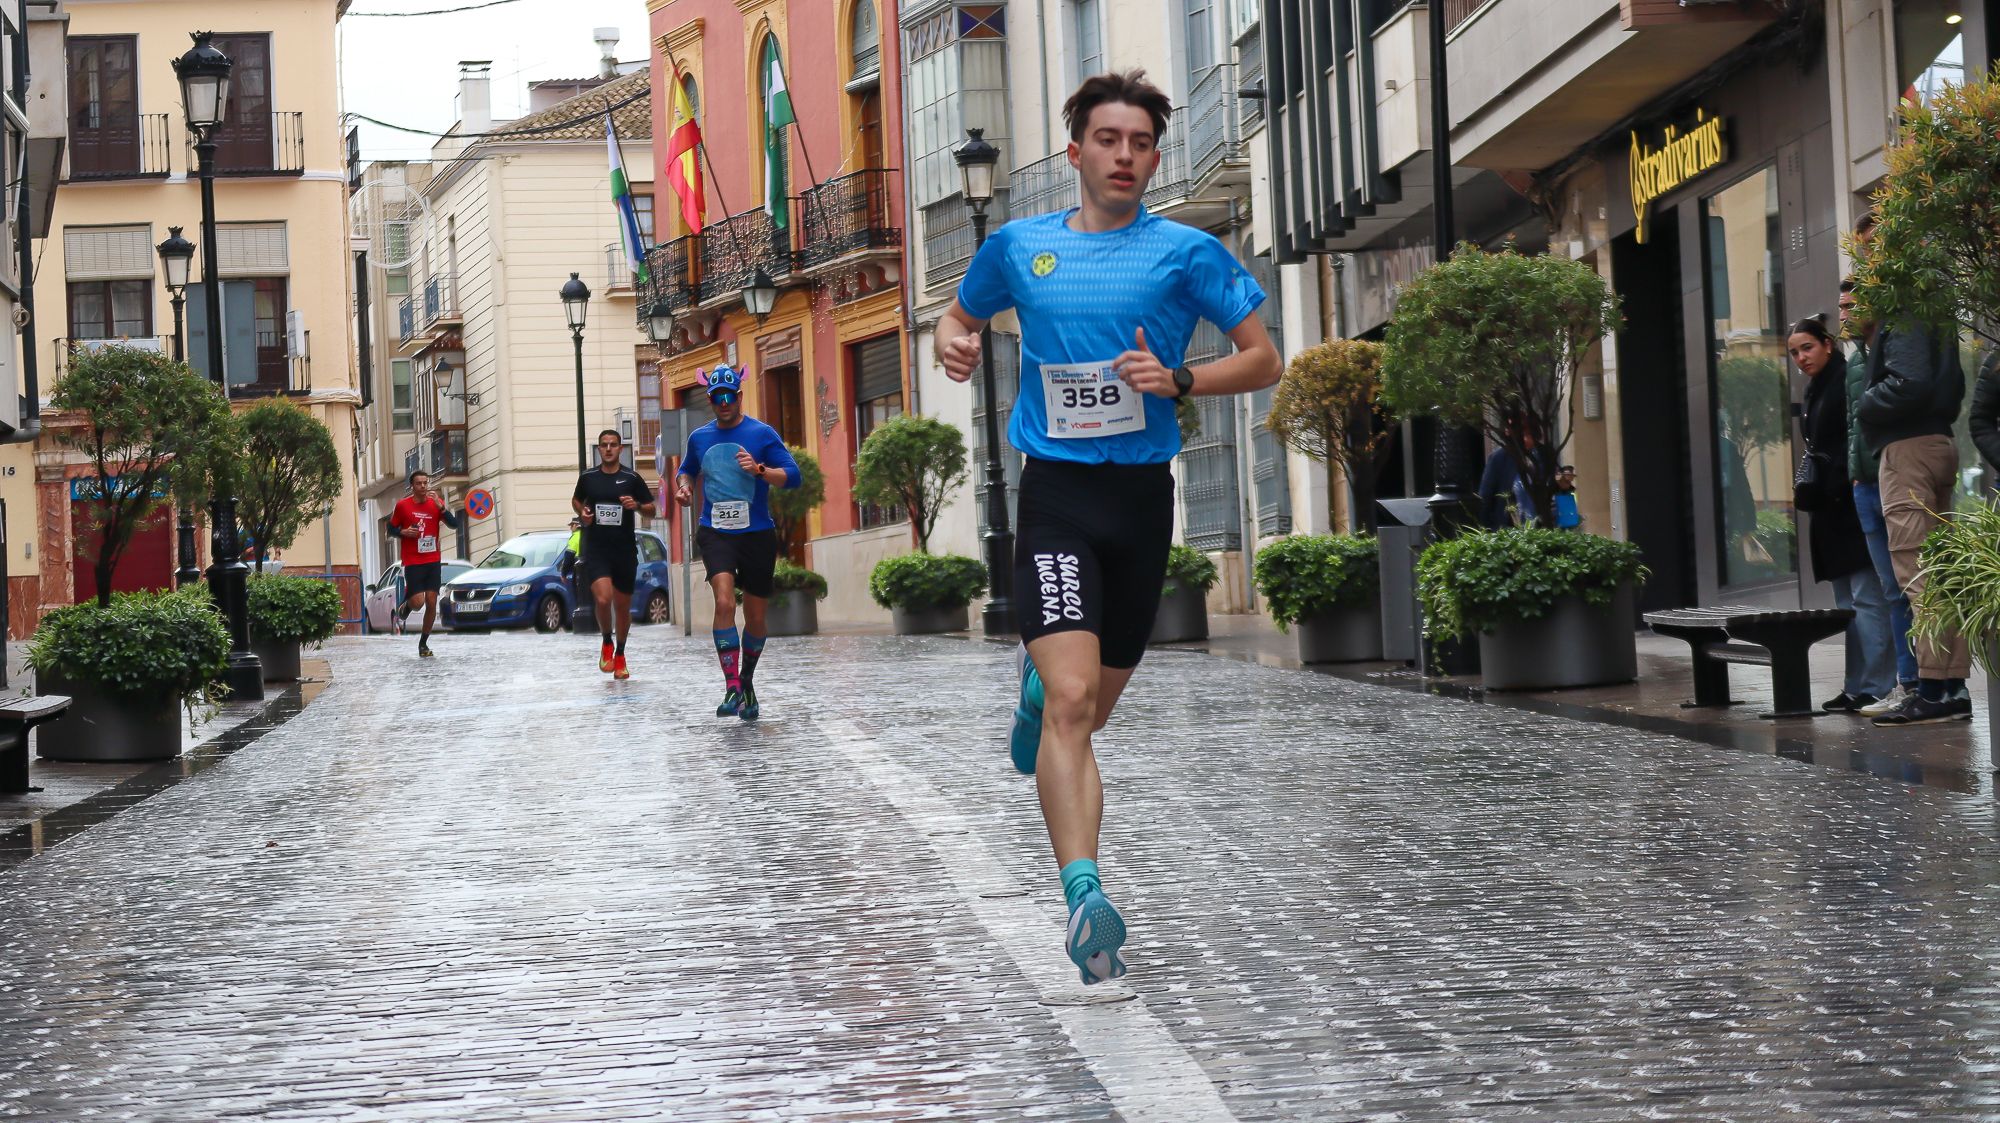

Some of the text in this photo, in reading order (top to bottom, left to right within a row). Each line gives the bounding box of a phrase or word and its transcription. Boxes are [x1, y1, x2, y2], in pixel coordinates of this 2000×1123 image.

[1062, 385, 1121, 408] 358
[3, 466, 15, 476] 15
[719, 510, 739, 518] 212
